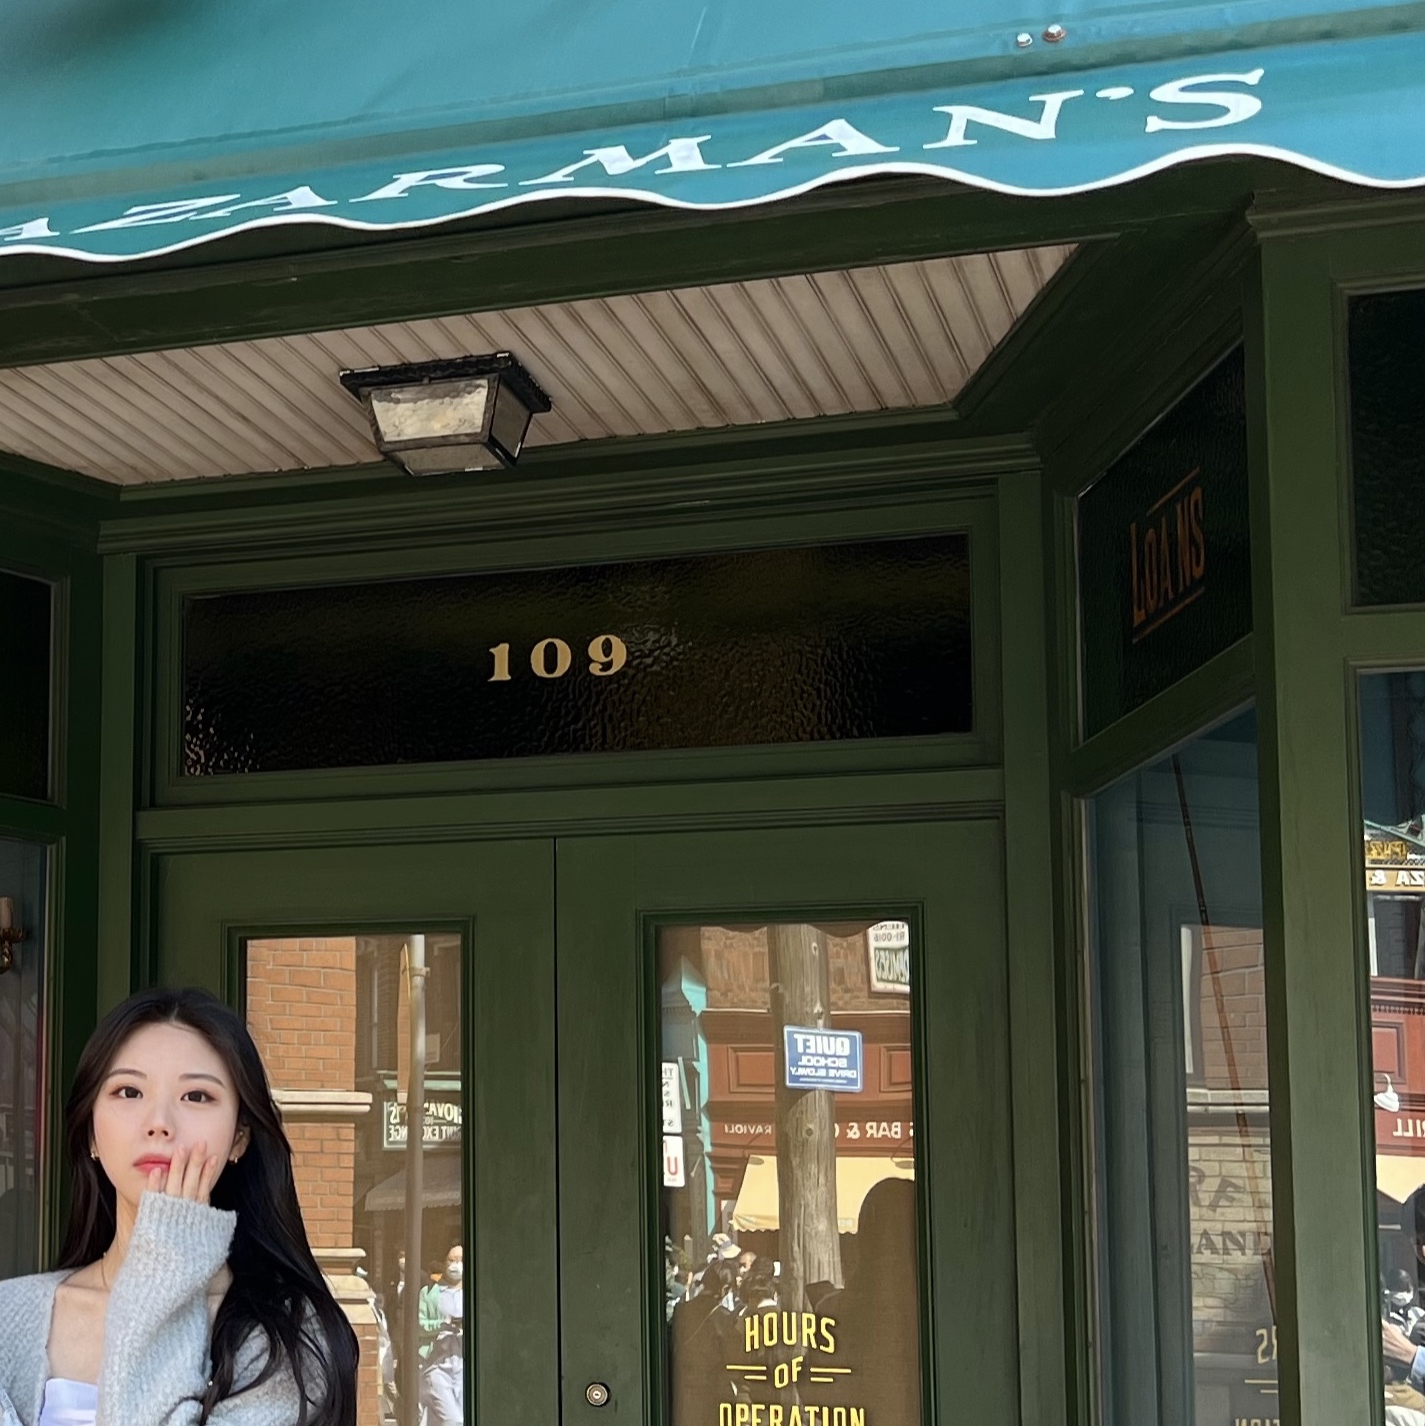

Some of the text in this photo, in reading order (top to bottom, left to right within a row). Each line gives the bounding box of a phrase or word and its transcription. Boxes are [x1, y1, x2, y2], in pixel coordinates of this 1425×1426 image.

[1130, 486, 1206, 628] LOANS
[488, 634, 628, 682] 109
[744, 1311, 838, 1354] HOURS
[774, 1356, 804, 1389] OF
